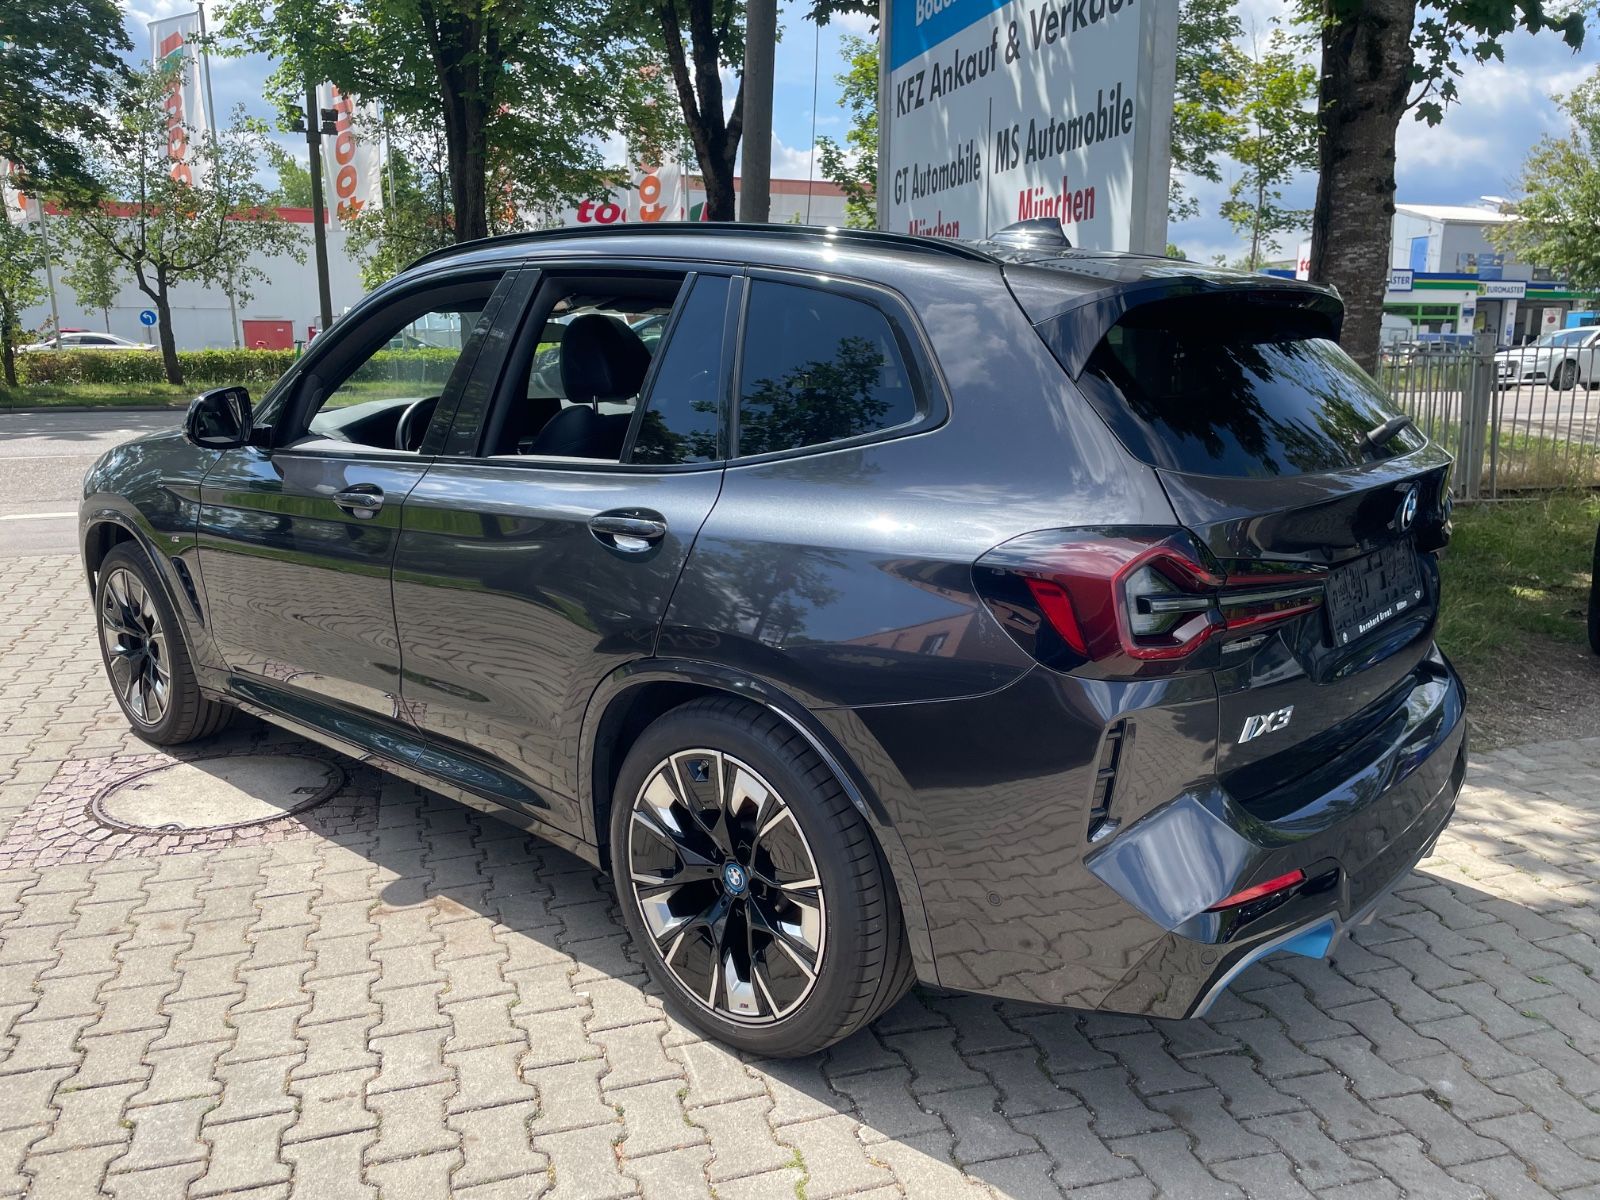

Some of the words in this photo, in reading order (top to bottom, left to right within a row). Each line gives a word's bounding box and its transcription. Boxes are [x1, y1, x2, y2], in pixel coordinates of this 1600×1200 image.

[896, 70, 925, 118] KFZ
[929, 26, 999, 102] Ankauf
[1005, 20, 1021, 65] &
[1029, 0, 1134, 51] Verkau
[995, 124, 1020, 174] MS
[1025, 82, 1134, 164] Automobile
[895, 166, 909, 206] GT
[911, 139, 982, 201] Automobile
[1018, 176, 1096, 225] München
[1486, 286, 1524, 294] EUROMASTER
